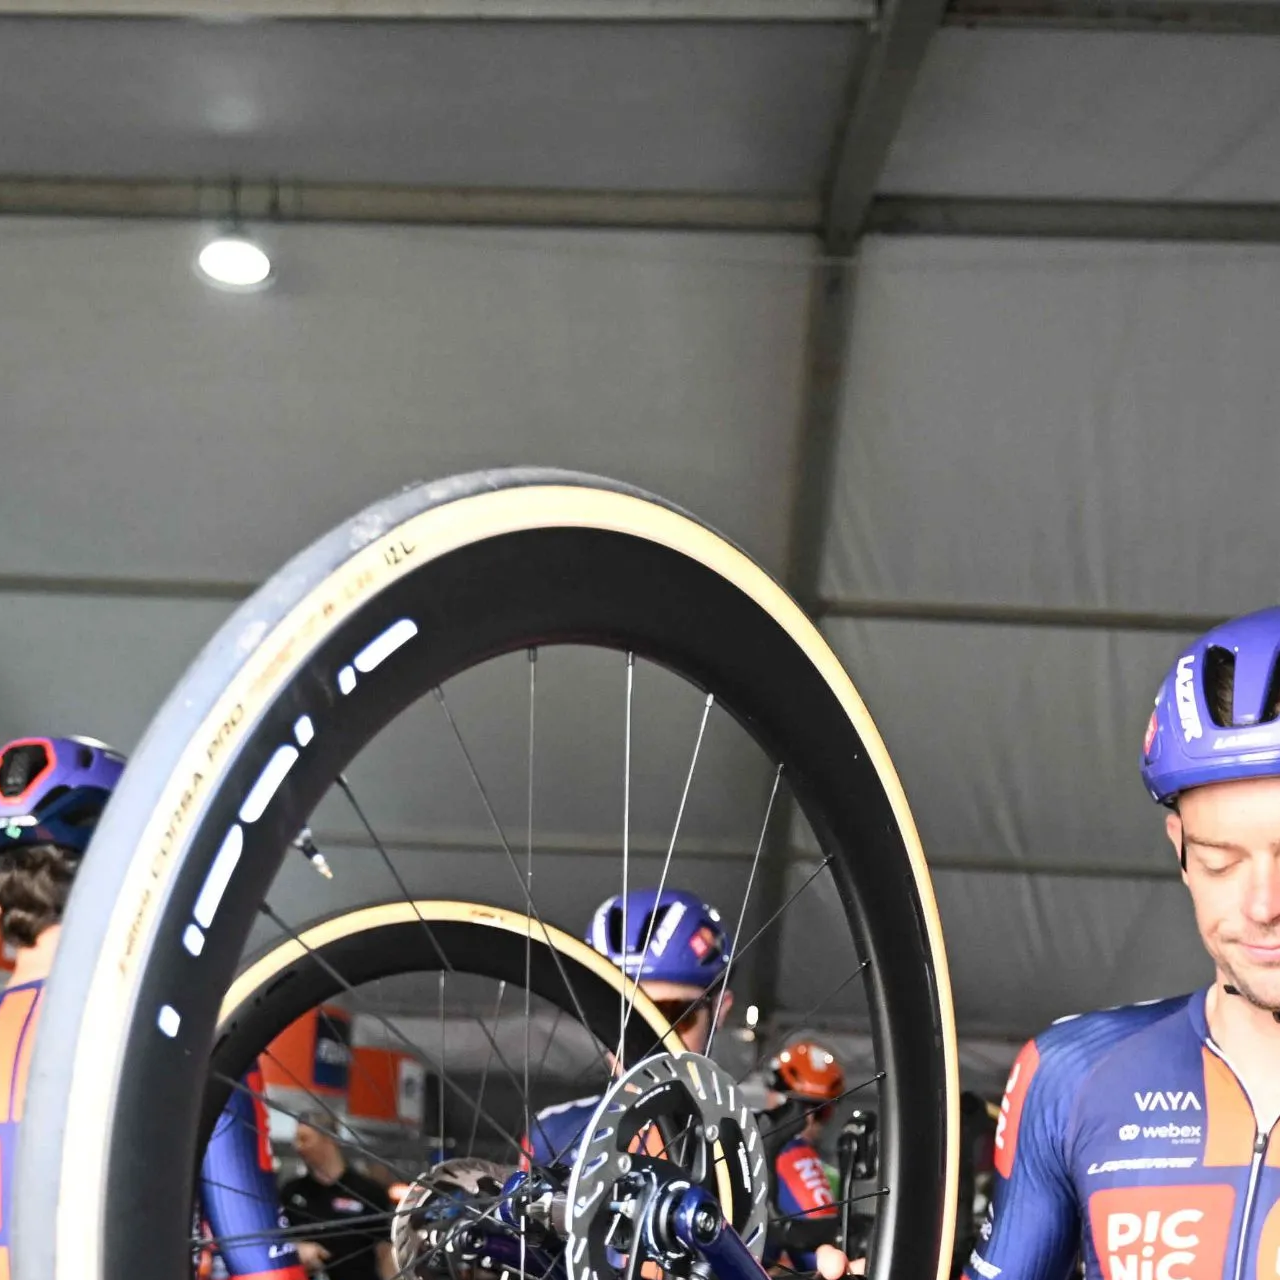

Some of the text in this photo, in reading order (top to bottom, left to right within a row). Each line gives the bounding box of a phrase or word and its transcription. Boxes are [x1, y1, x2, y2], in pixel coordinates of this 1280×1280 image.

[1134, 1091, 1201, 1111] VAYA
[1143, 1124, 1201, 1139] webex
[1108, 1209, 1203, 1252] PIC
